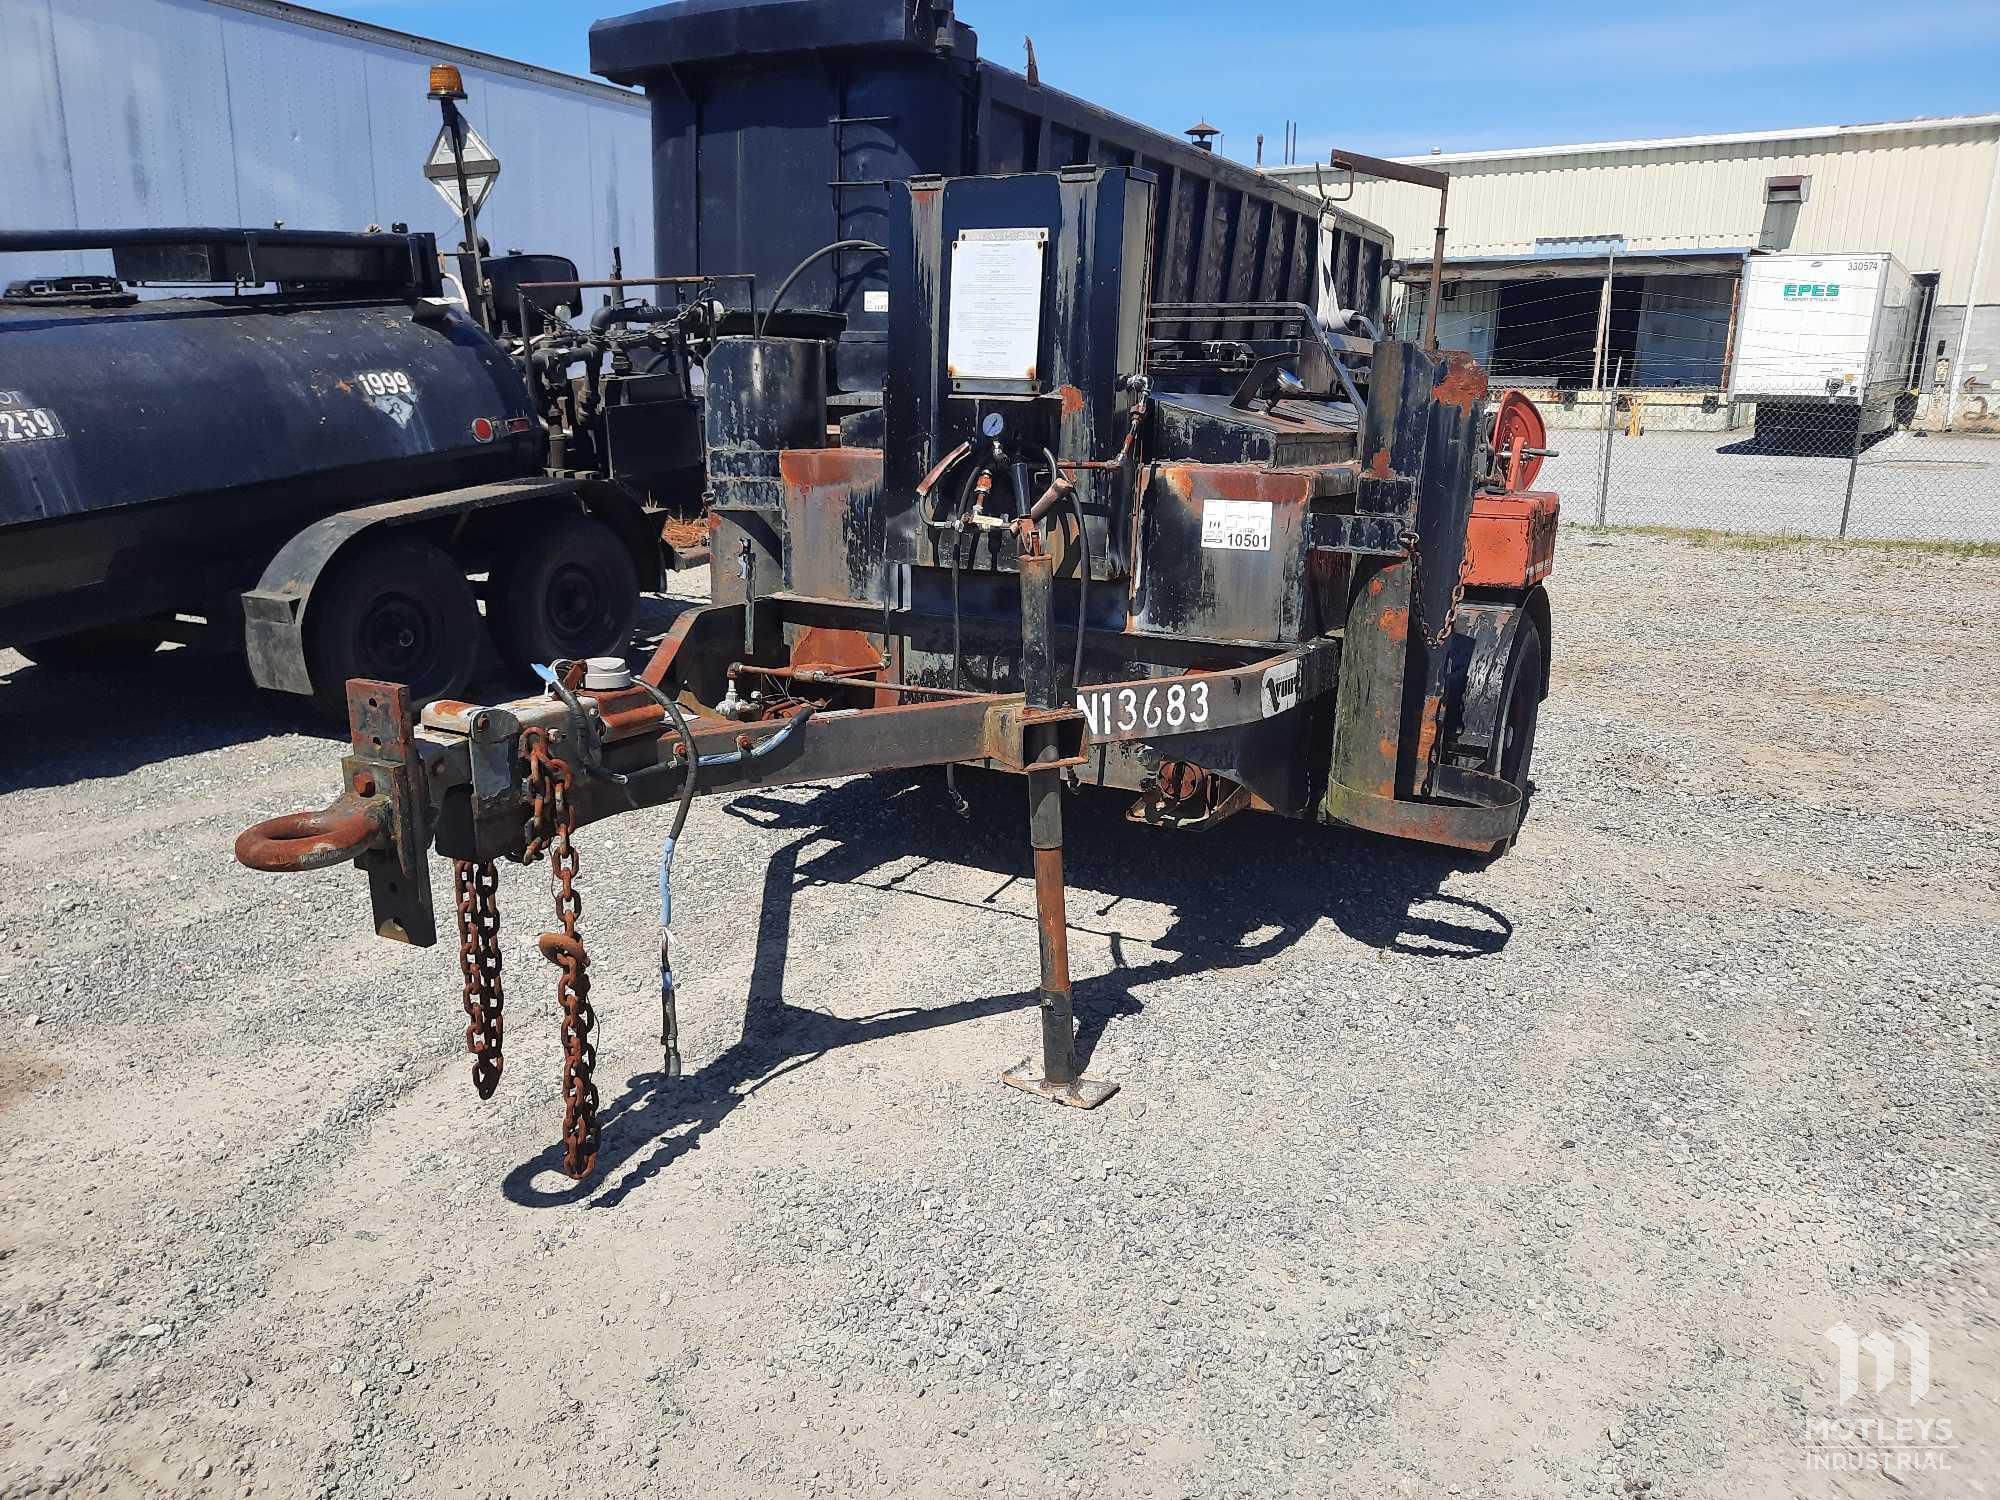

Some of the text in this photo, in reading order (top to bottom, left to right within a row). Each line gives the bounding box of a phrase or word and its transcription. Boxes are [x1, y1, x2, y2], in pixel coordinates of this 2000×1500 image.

[1847, 261, 1878, 271] 330574
[1783, 284, 1840, 297] EPES
[358, 371, 412, 396] 1999
[0, 409, 55, 440] 259
[1227, 532, 1267, 548] 10501
